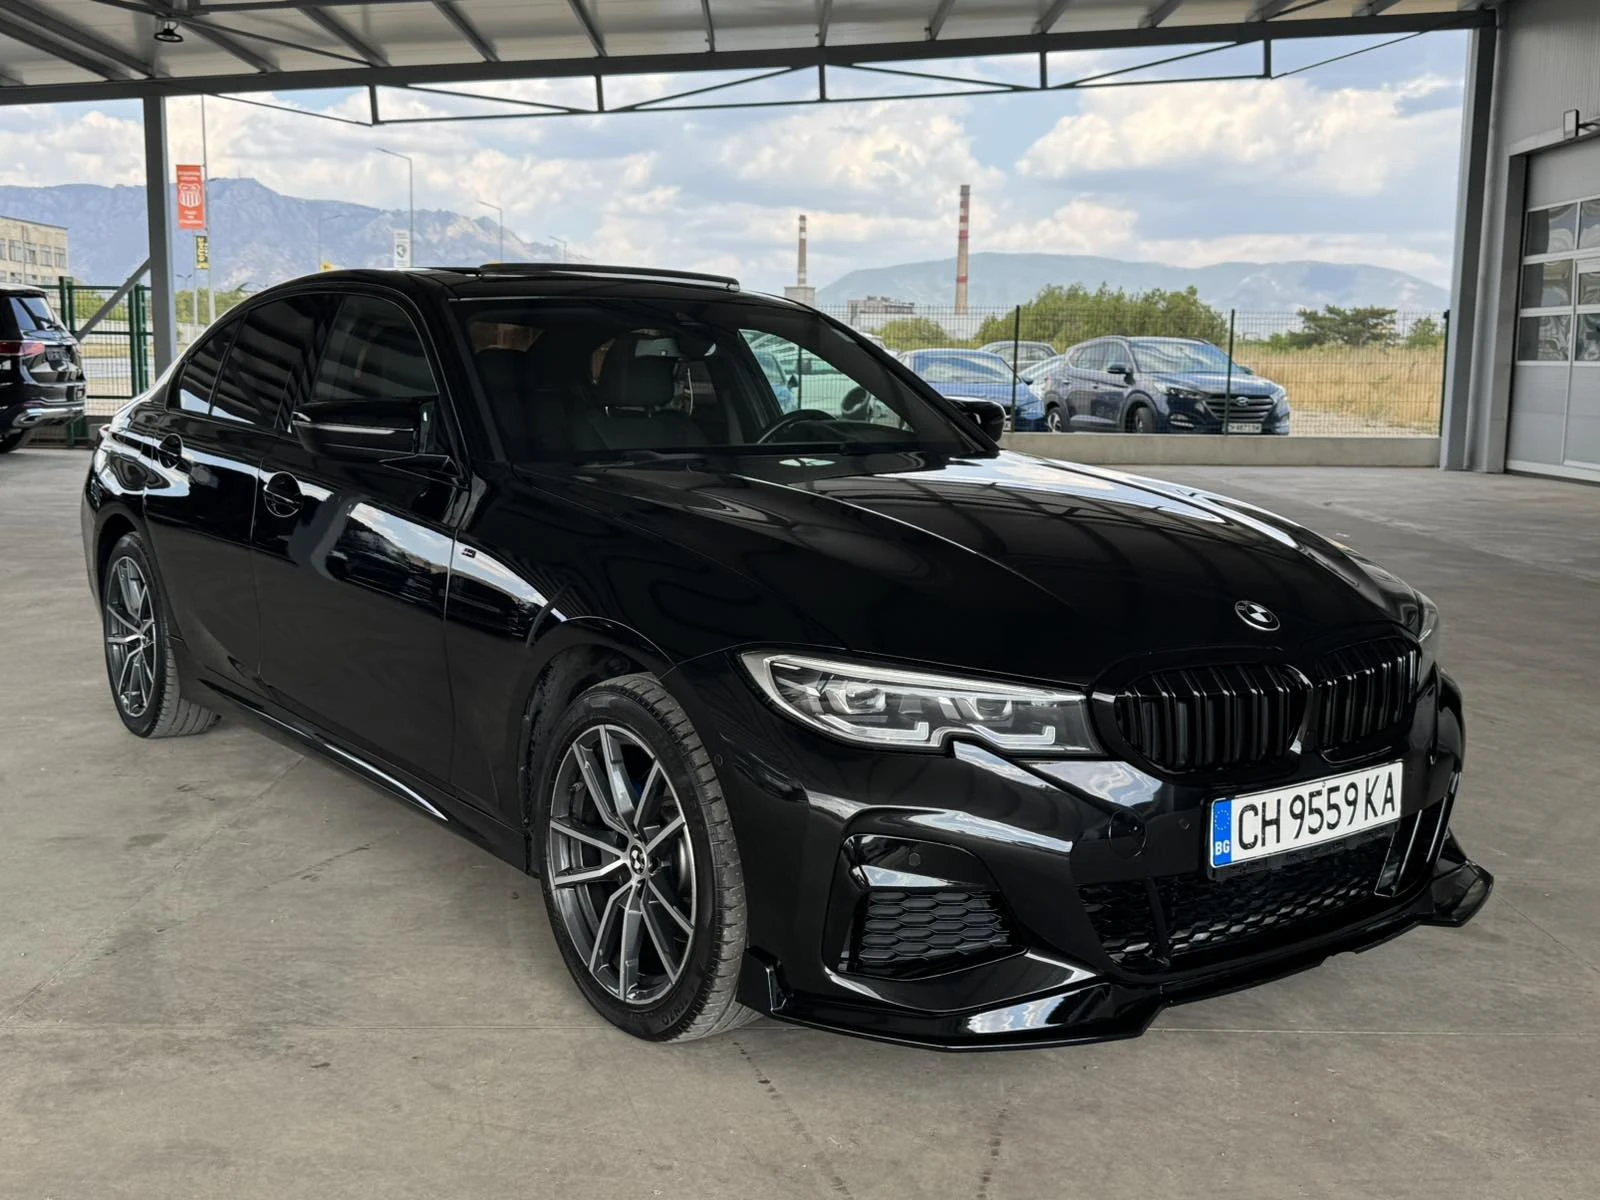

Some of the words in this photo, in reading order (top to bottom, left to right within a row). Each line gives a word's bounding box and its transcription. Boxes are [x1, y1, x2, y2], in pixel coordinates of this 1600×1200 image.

[1238, 798, 1281, 851] CH
[1289, 782, 1359, 840] 9559
[1364, 771, 1395, 821] KA
[1215, 840, 1231, 856] BG
